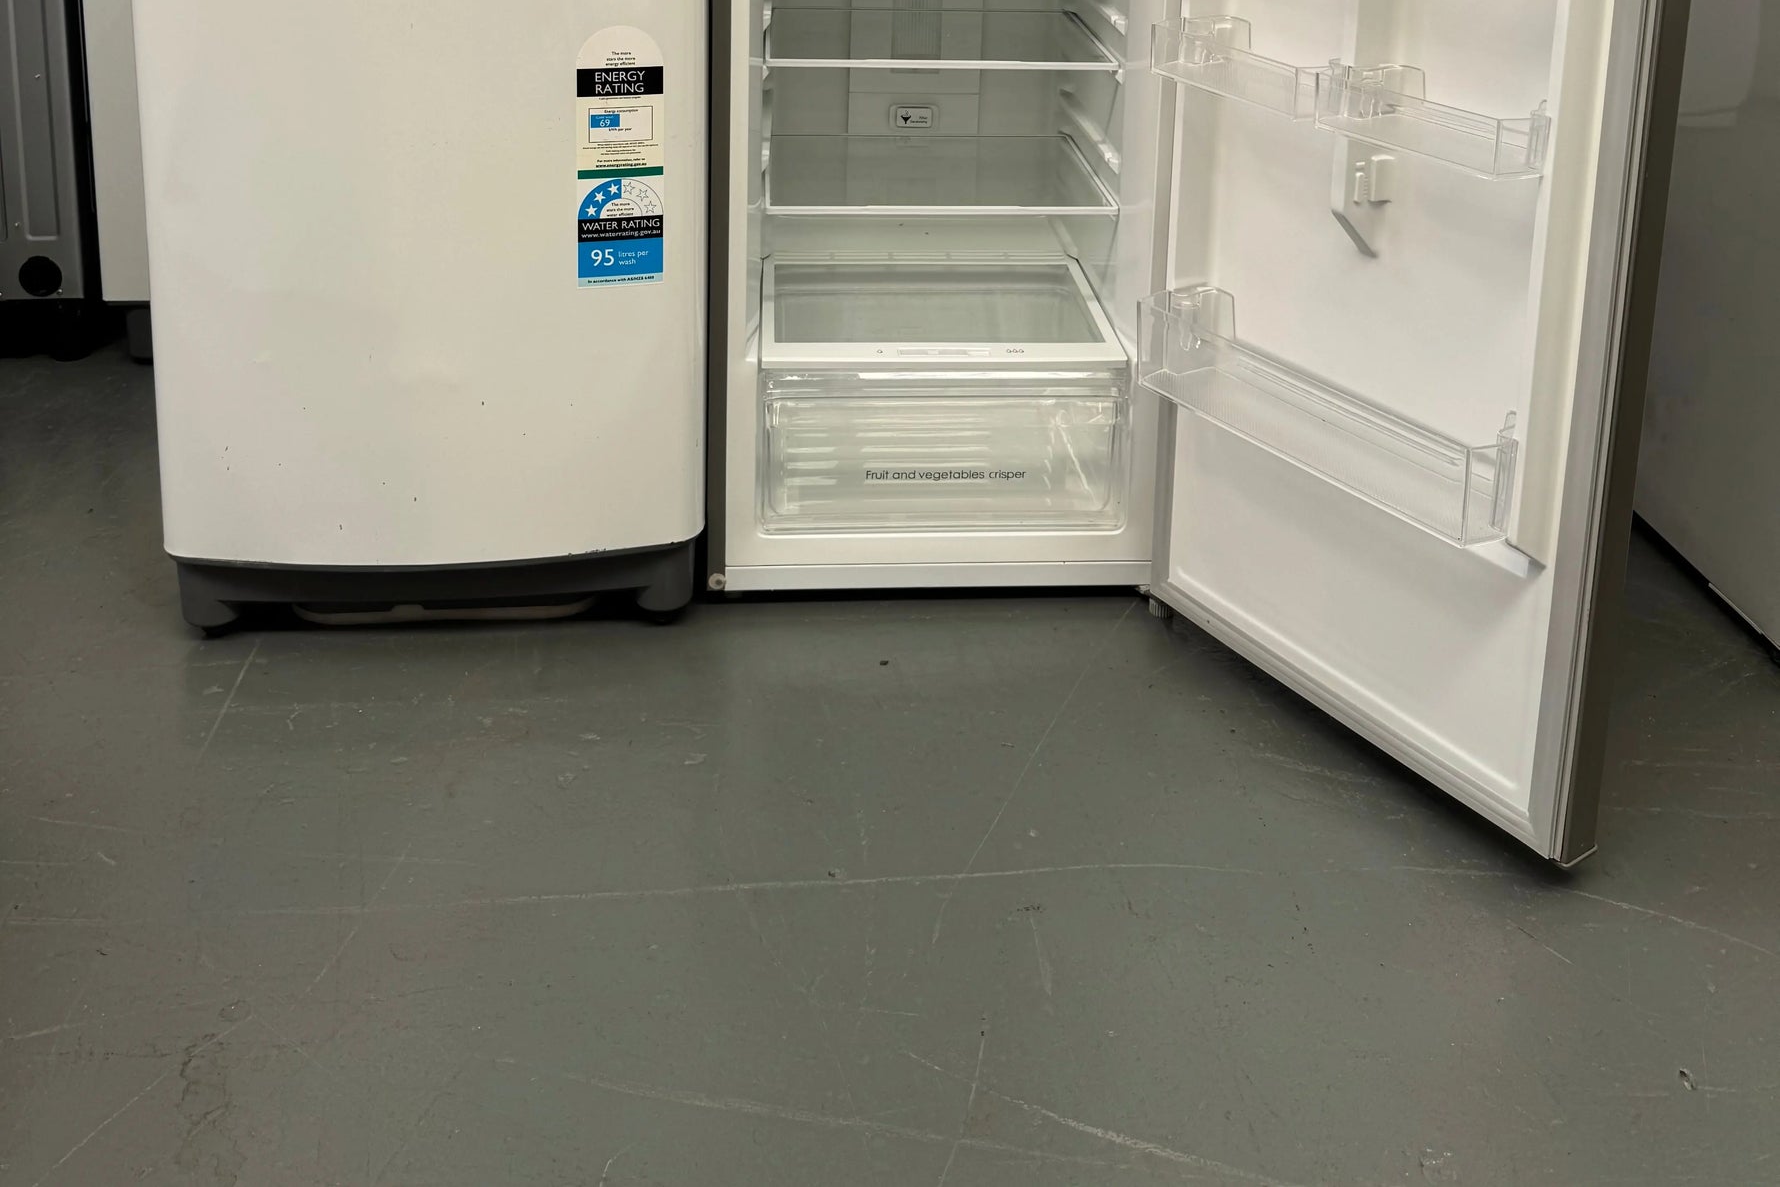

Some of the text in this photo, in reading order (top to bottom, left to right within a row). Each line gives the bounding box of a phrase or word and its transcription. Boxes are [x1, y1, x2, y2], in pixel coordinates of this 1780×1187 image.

[594, 70, 645, 82] ENERGY
[595, 82, 644, 94] RATING
[600, 119, 611, 127] 69
[582, 219, 660, 231] WATER RATING
[581, 230, 661, 238] www.waterrating.gov.au
[591, 249, 615, 266] 95
[865, 470, 1027, 481] Fruit and vegetables crisper
